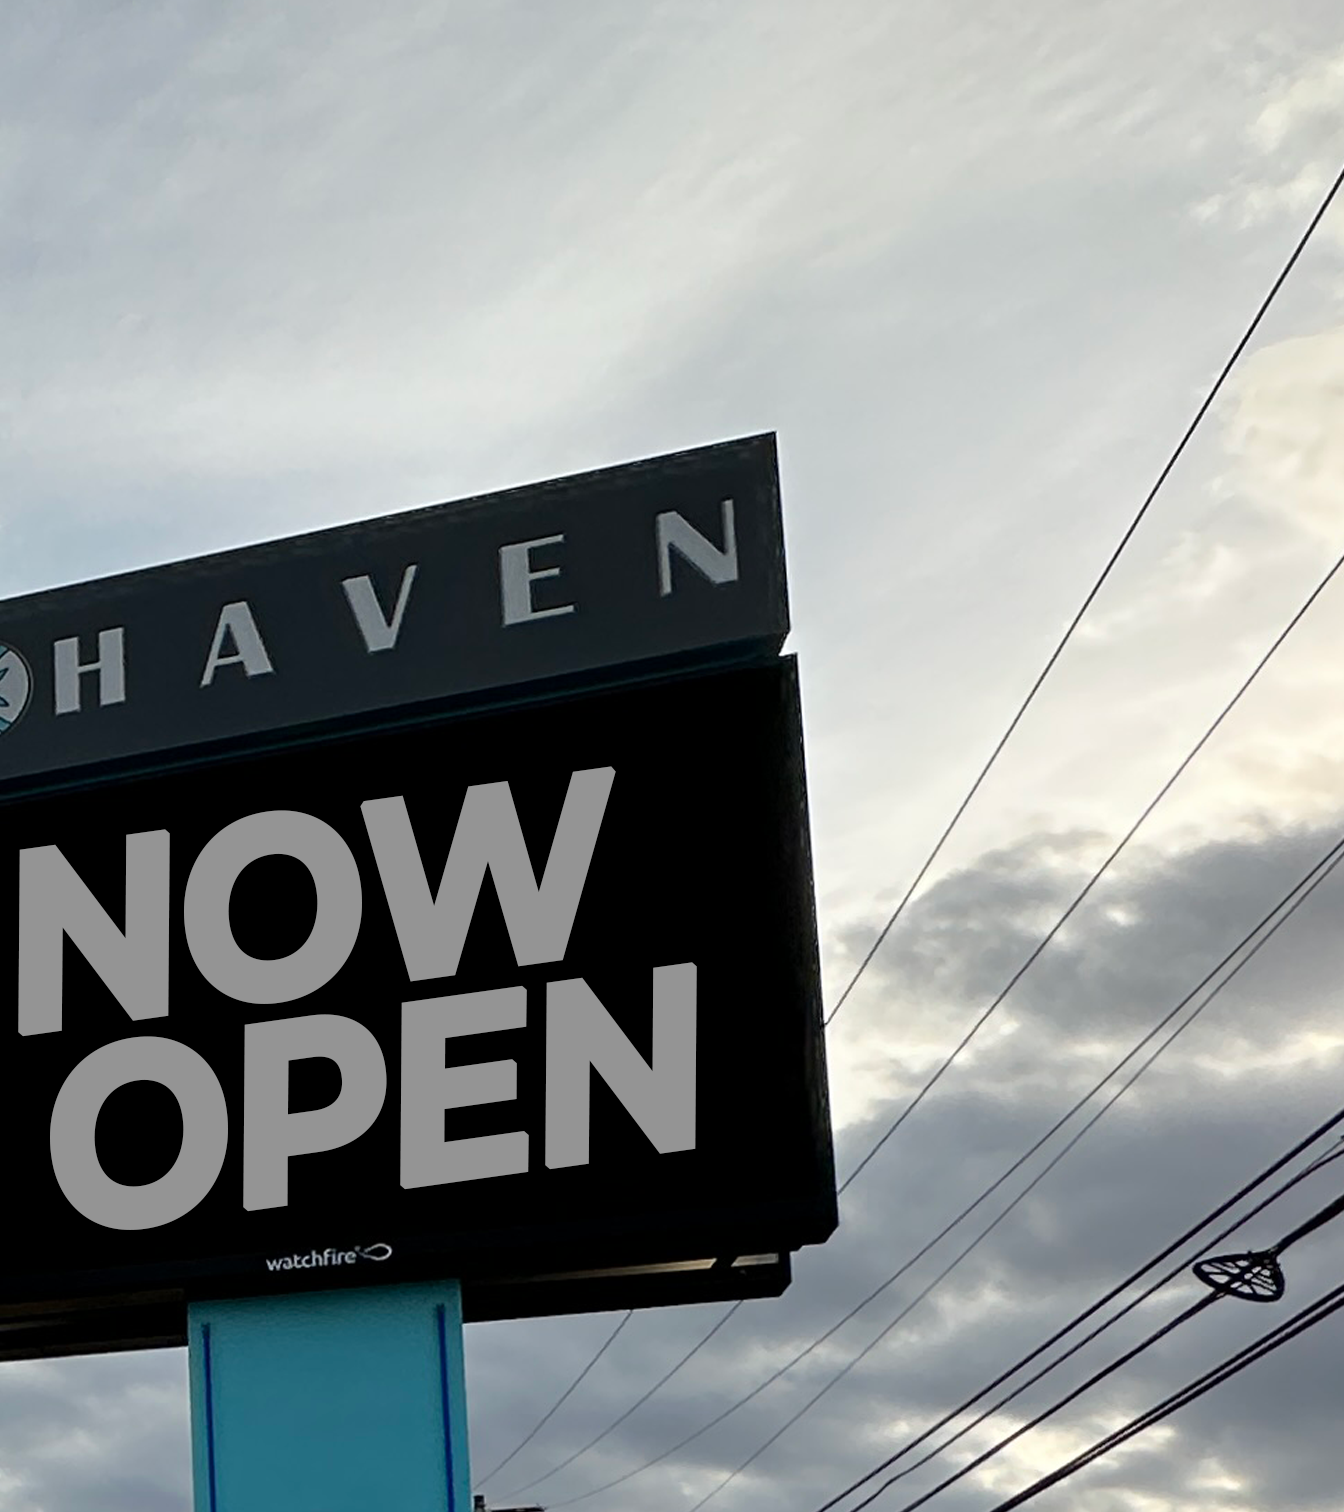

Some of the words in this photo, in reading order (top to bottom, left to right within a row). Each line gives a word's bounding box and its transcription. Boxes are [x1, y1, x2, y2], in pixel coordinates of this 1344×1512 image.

[53, 499, 739, 716] HAVEN
[17, 765, 617, 1037] NOW
[49, 961, 698, 1231] OPEN
[265, 1248, 357, 1272] watchfire
